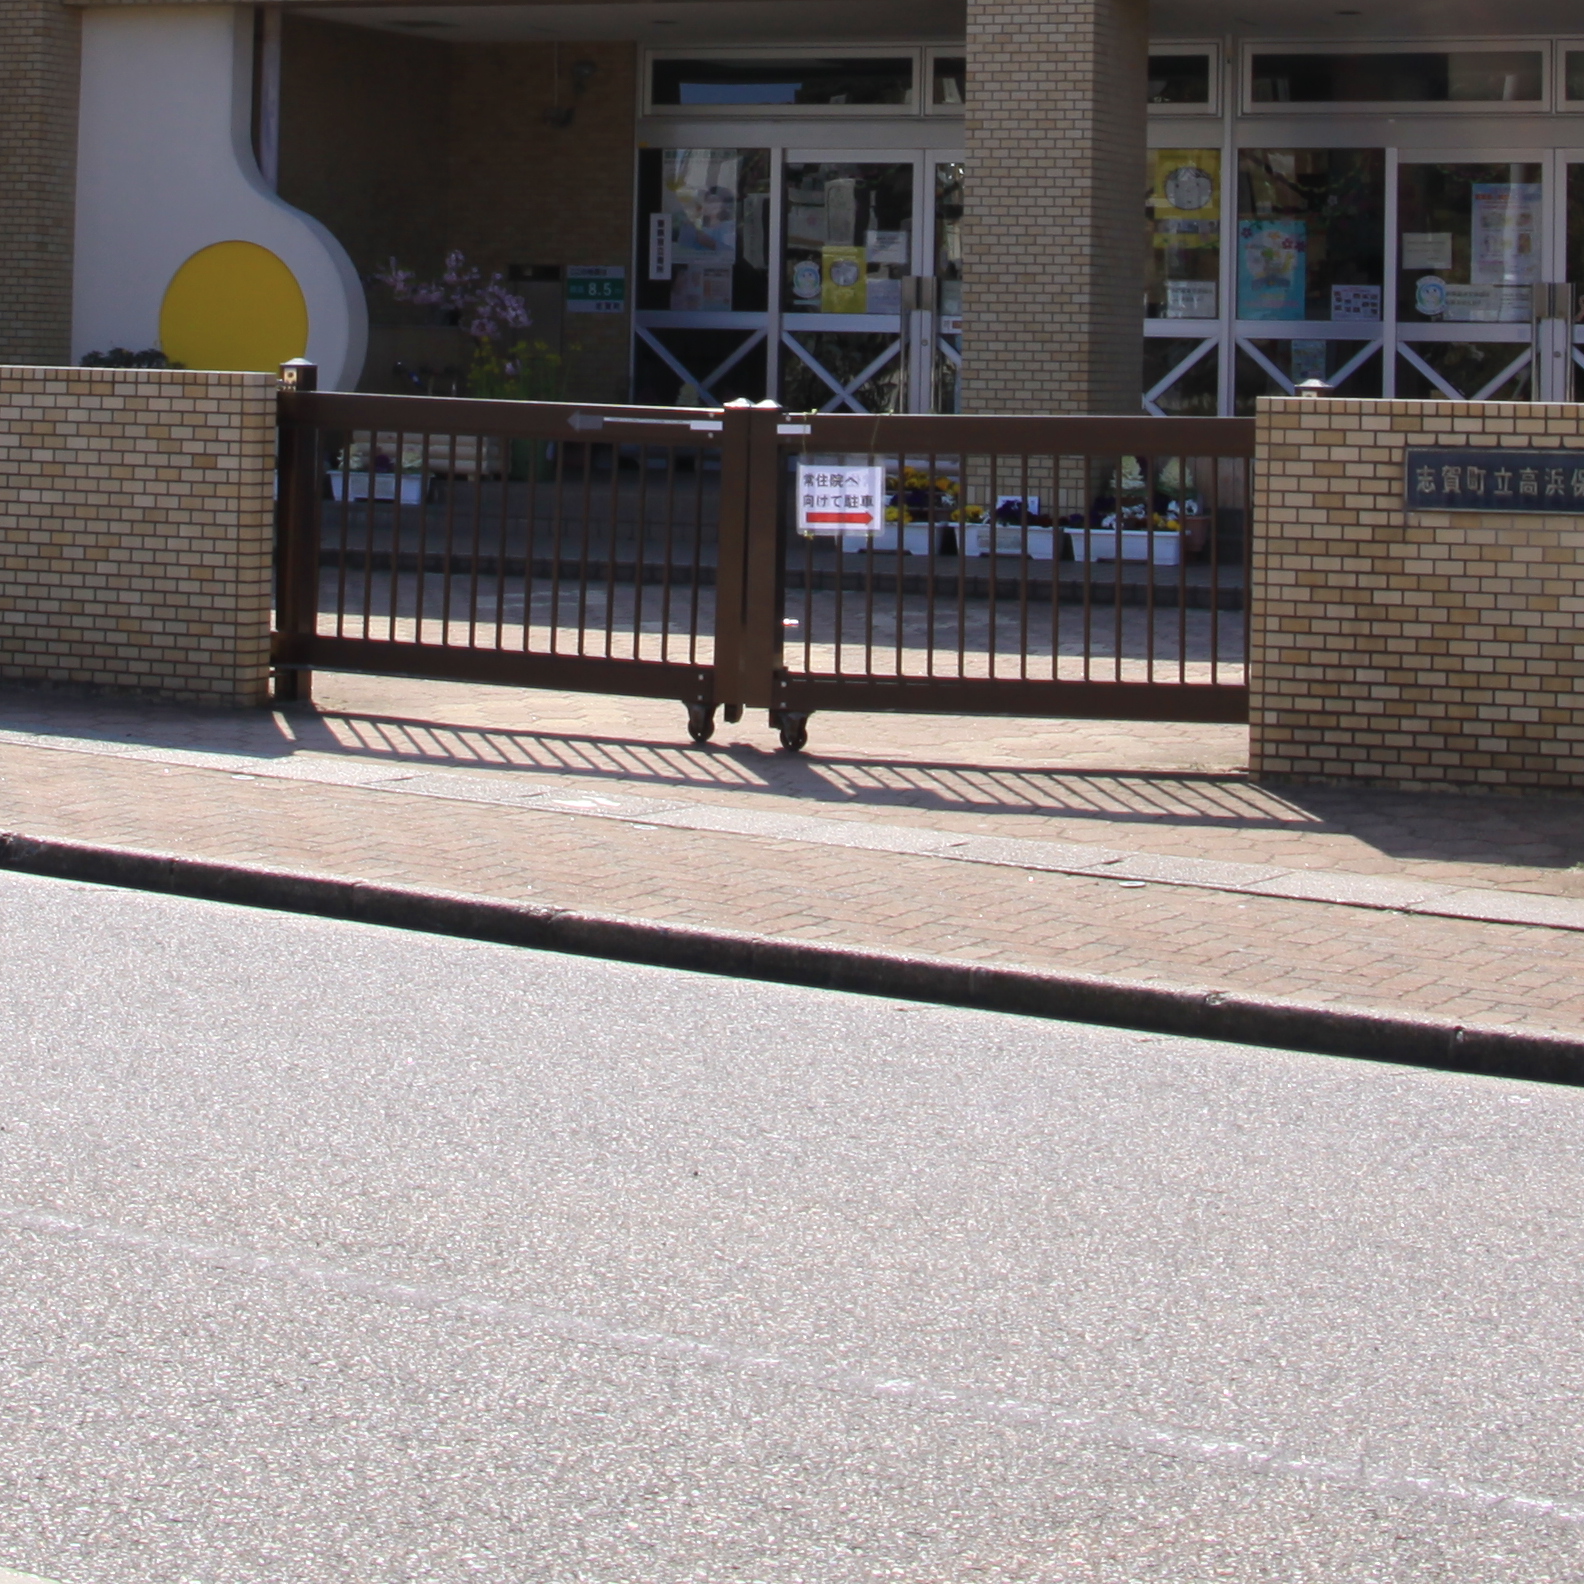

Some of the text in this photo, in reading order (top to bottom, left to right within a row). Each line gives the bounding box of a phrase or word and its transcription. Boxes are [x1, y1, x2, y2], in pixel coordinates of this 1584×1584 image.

[803, 473, 859, 488] 常住院へ
[803, 494, 874, 508] 向けて駐車
